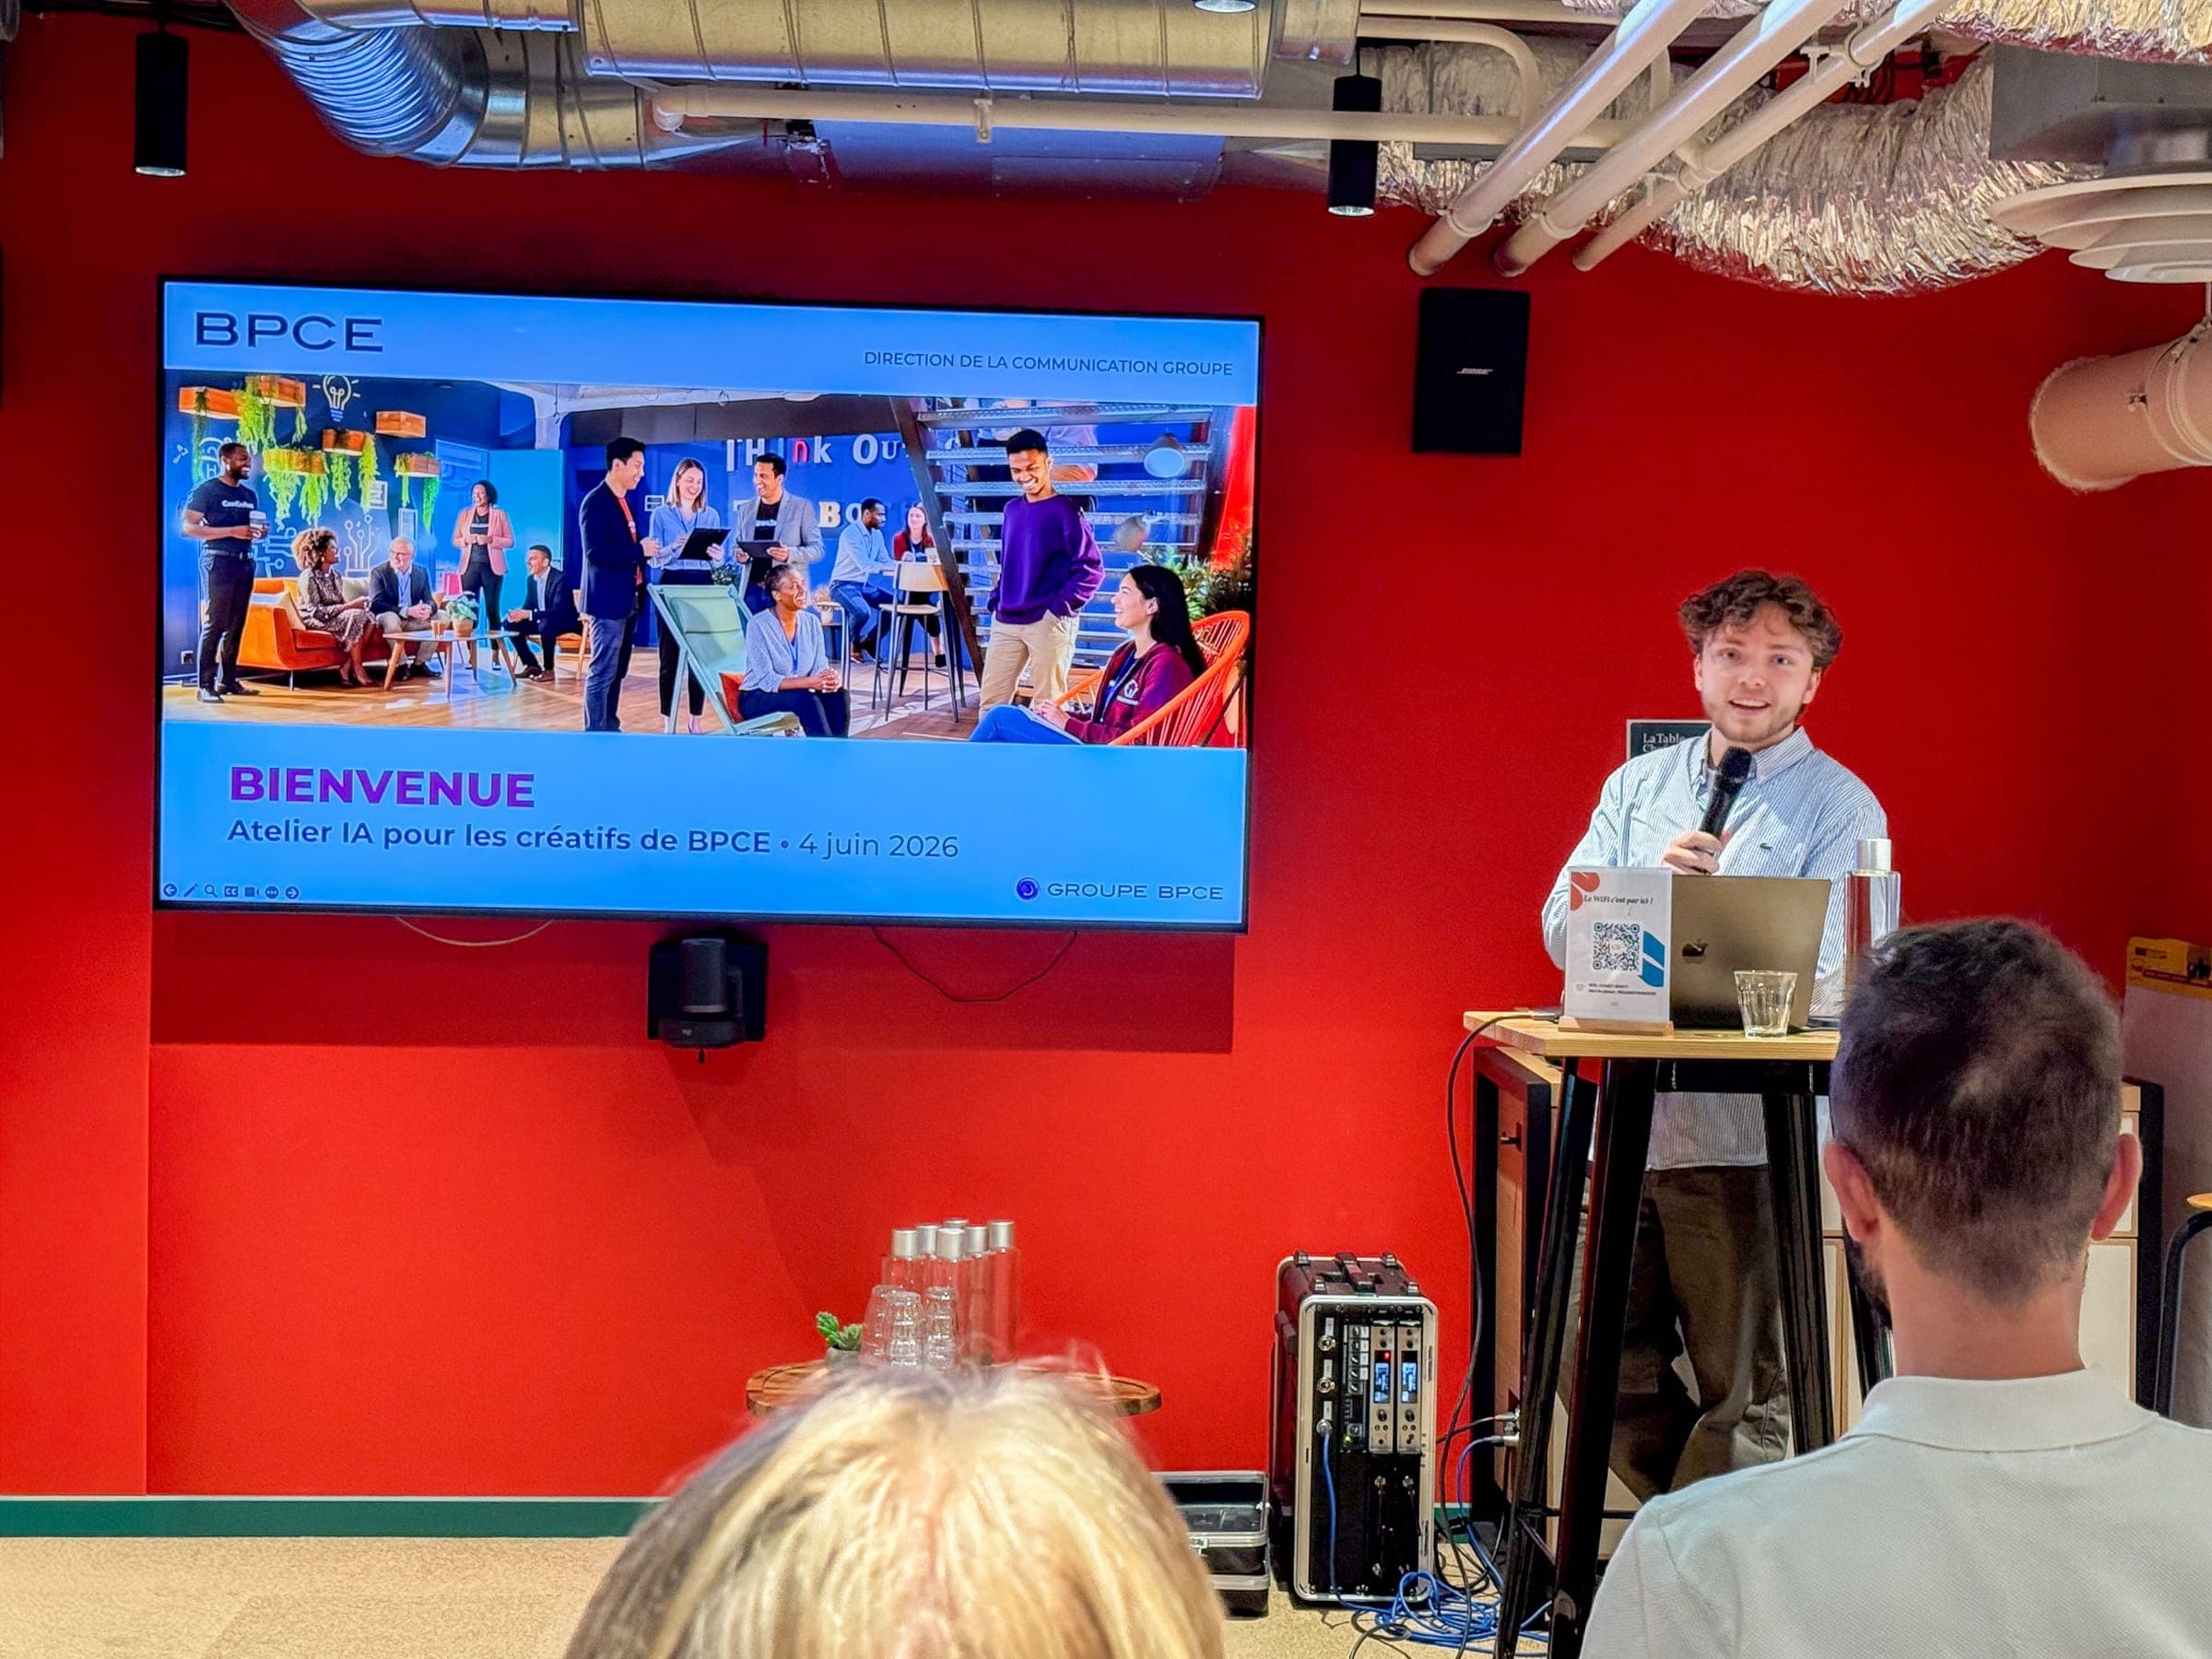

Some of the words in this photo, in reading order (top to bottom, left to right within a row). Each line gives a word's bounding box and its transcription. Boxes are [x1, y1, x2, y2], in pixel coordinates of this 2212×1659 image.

[195, 312, 383, 352] BPCE
[865, 351, 955, 368] DIRECTION
[960, 354, 983, 369] DE
[987, 355, 1007, 370] LA
[1012, 356, 1159, 374] COMMUNICATION
[1163, 360, 1233, 376] GROUPE
[1643, 733, 1655, 744] La
[230, 766, 535, 808] BIENVENUE
[228, 818, 333, 843] Atelier
[343, 821, 374, 844] IA
[383, 827, 456, 850] pour
[465, 823, 507, 847] les
[516, 825, 630, 850] créatifs
[641, 828, 677, 851] de
[688, 830, 771, 853] BPCE
[799, 832, 818, 854] 4
[823, 831, 879, 860] juin
[888, 834, 959, 858] 2026
[1047, 882, 1147, 899] GROUPE
[1159, 885, 1224, 900] BPCE
